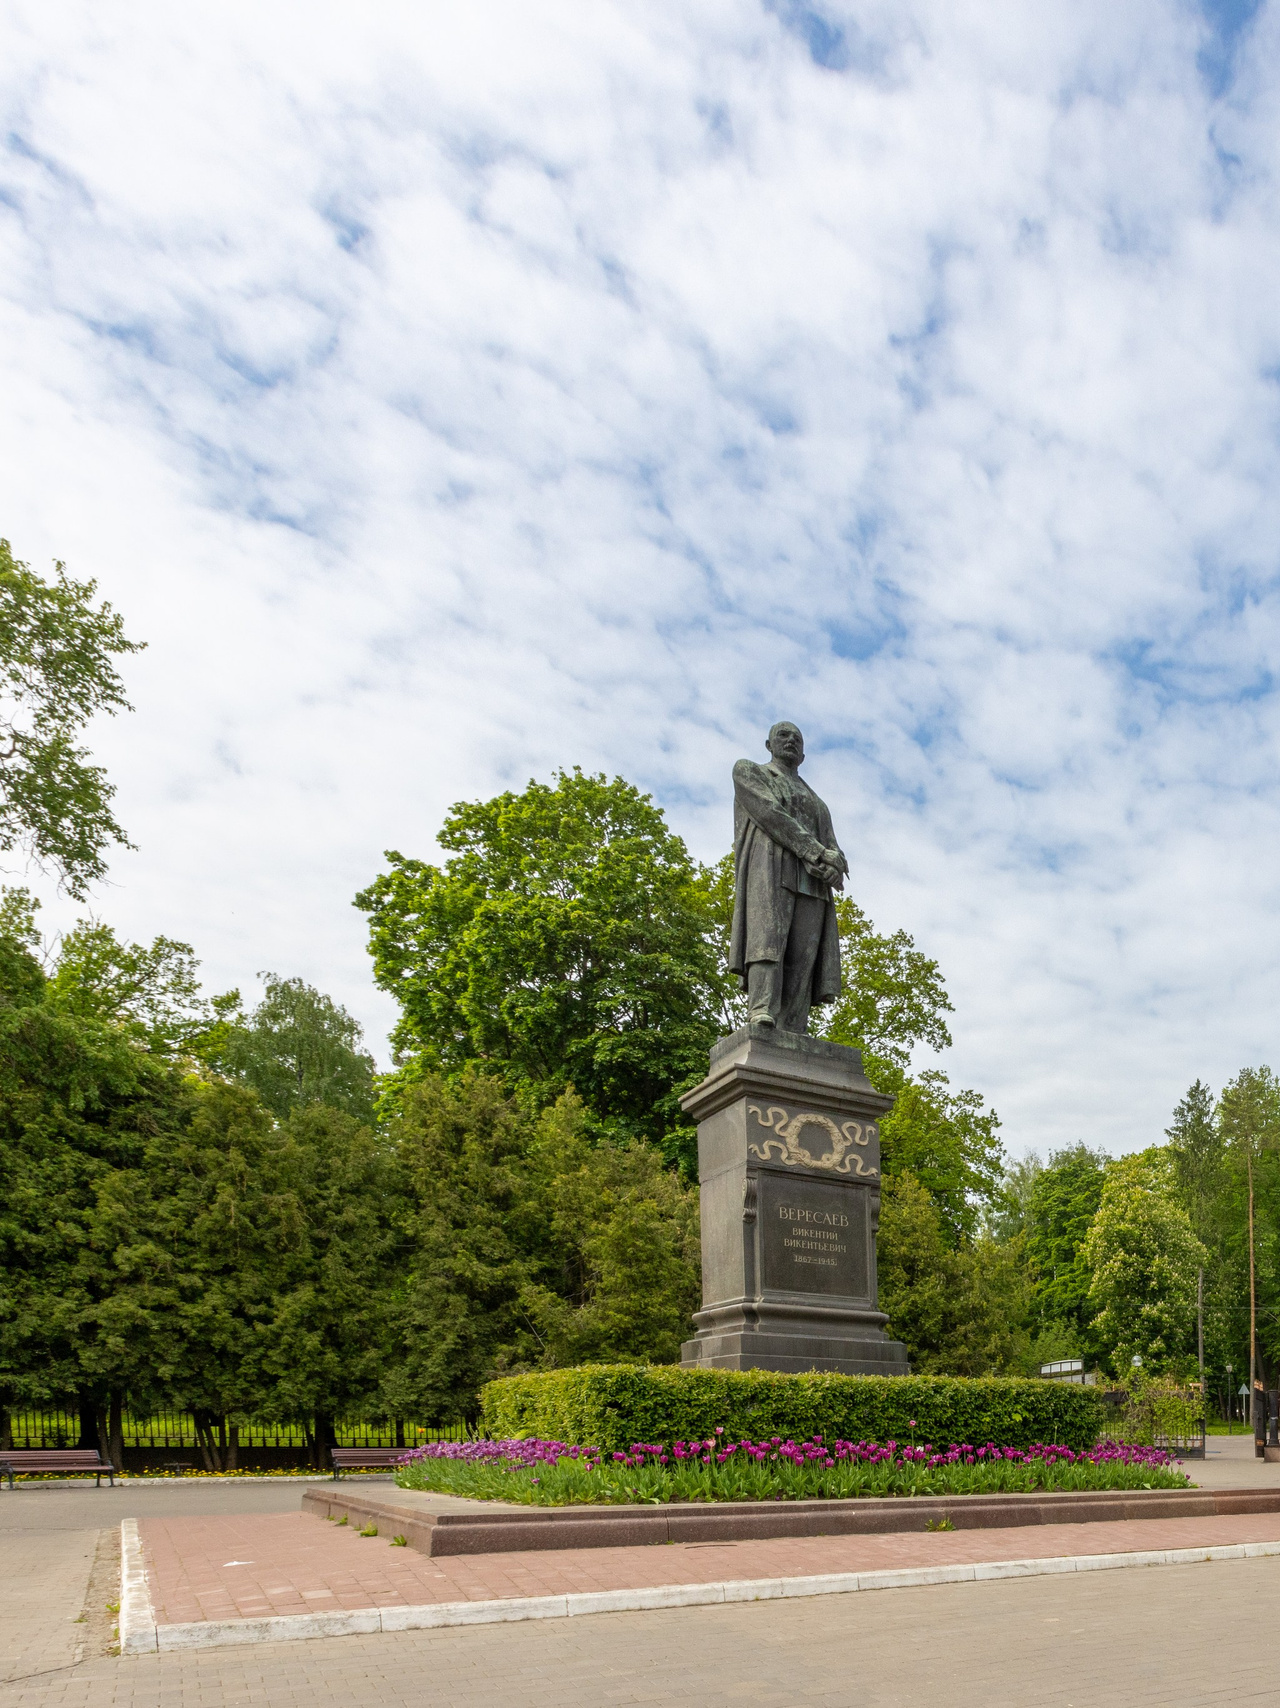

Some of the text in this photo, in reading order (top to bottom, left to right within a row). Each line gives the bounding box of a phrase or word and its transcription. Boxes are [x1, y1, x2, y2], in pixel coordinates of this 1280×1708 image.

[779, 1206, 849, 1227] ВЕРЕСАЕВ
[792, 1227, 838, 1240] ВИКЕНТИЙ
[784, 1238, 847, 1253] ВИКЕНТЬЕВИЧ
